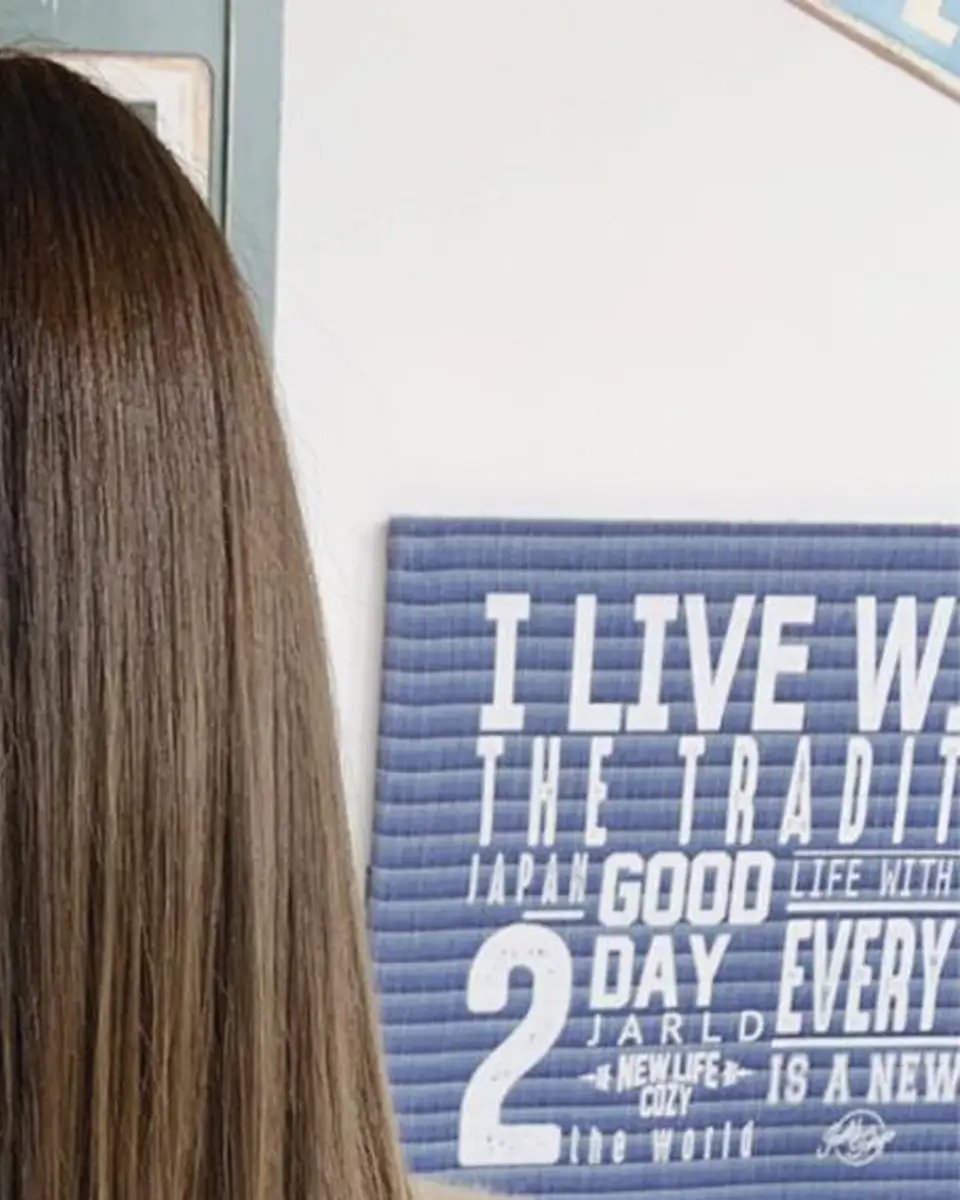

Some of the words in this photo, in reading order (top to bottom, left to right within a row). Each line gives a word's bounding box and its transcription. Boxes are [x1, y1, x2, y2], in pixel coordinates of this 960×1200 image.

[479, 592, 531, 732] I
[567, 592, 817, 733] LIVE
[475, 734, 615, 848] THE
[465, 851, 589, 906] JAPAN
[597, 849, 776, 928] GOOD
[789, 857, 864, 898] LIFE
[878, 857, 954, 898] WITH
[588, 932, 732, 1010] DAY
[774, 917, 958, 1034] EVERY
[457, 922, 574, 1168] 2
[586, 1009, 765, 1047] JARLD
[639, 1083, 693, 1118] COZY
[766, 1053, 810, 1105] IS
[822, 1052, 850, 1105] A
[569, 1124, 628, 1165] the
[651, 1120, 755, 1163] world
